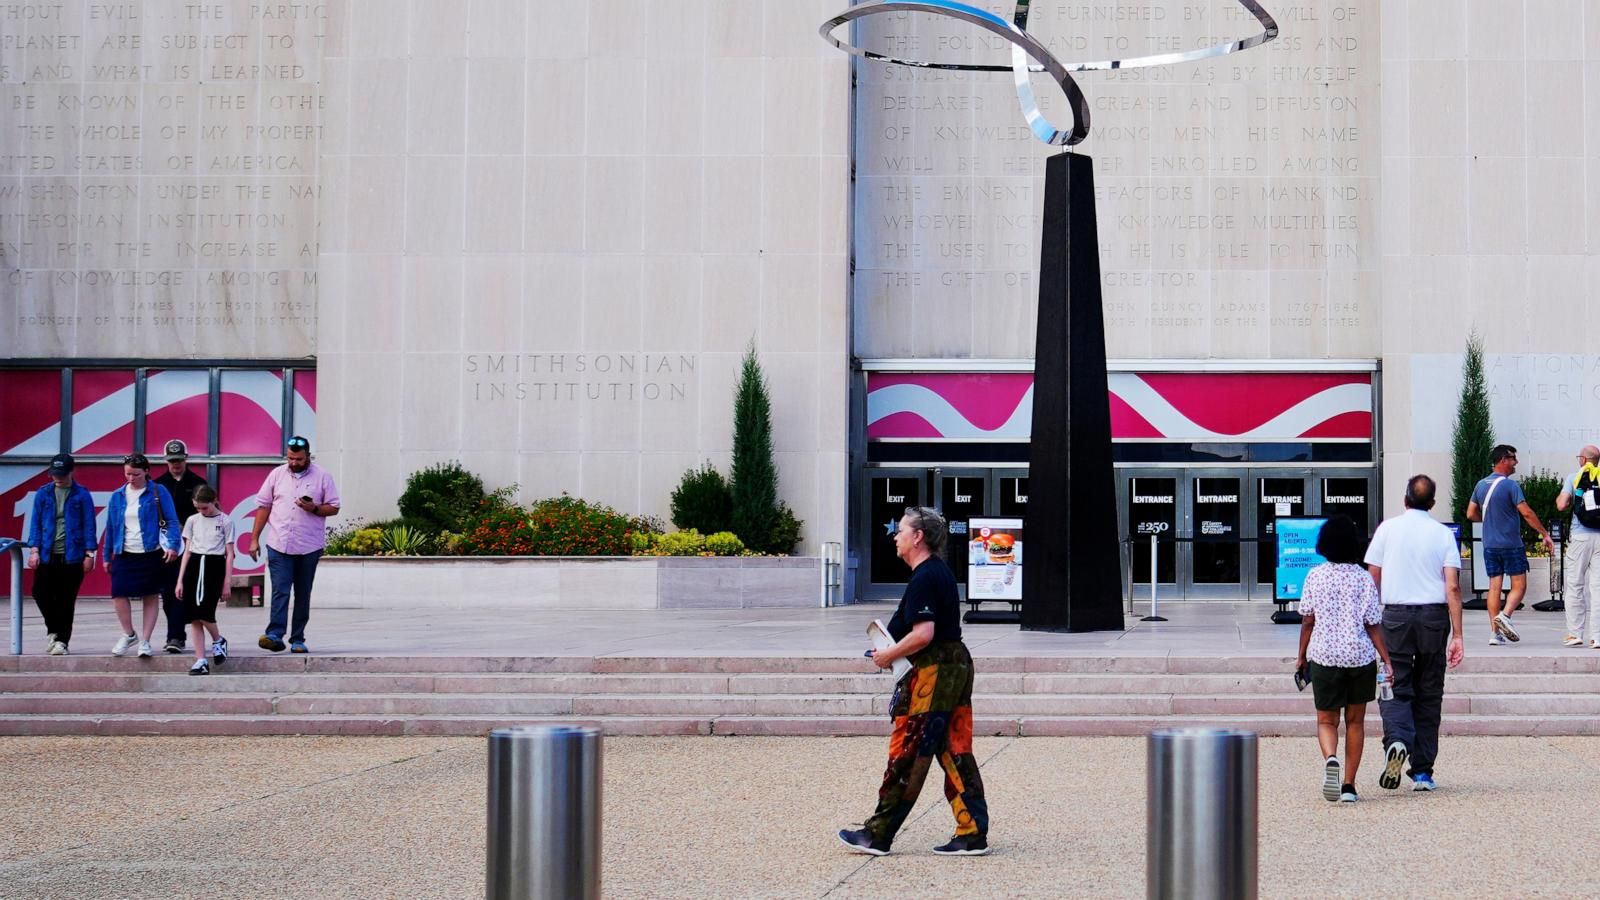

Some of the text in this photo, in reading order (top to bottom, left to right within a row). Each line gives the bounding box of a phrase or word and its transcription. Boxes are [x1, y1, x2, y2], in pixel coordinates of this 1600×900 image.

[0, 5, 64, 19] HOUT
[90, 5, 137, 19] EVIL
[185, 5, 224, 19] THE
[1057, 6, 1166, 21] FURNISHED
[1183, 6, 1207, 21] BY
[1333, 7, 1357, 21] OF
[101, 35, 141, 49] ARE
[160, 35, 248, 49] SUBJECT
[265, 35, 294, 49] TO
[883, 36, 920, 50] THE
[1047, 36, 1088, 50] AND
[1103, 36, 1129, 50] TO
[1145, 36, 1182, 50] THE
[1315, 36, 1358, 50] AND
[32, 65, 73, 80] AND
[91, 65, 152, 80] WHAT
[174, 65, 190, 80] IS
[211, 65, 305, 80] LEARNED
[1192, 66, 1215, 81] AS
[1232, 66, 1257, 81] BY
[1273, 67, 1357, 81] HIMSELF
[12, 95, 36, 110] BE
[57, 95, 137, 110] KNOWN
[159, 95, 184, 110] OF
[207, 95, 245, 110] THE
[884, 96, 984, 111] DECLARED
[1190, 96, 1232, 111] AND
[17, 125, 54, 140] THE
[71, 125, 141, 140] WHOLE
[160, 125, 186, 140] OF
[201, 125, 228, 140] MY
[885, 126, 911, 141] OF
[1093, 126, 1150, 141] MONG
[1174, 126, 1216, 141] MEN
[1248, 126, 1281, 141] HIS
[1302, 126, 1358, 141] NAME
[73, 155, 144, 170] STATES
[167, 155, 193, 170] OF
[958, 156, 981, 171] BE
[1151, 156, 1257, 171] ENROLLED
[1282, 156, 1359, 171] AMONG
[157, 185, 220, 200] UNDER
[235, 185, 271, 200] THE
[882, 186, 920, 200] THE
[1214, 186, 1241, 200] OF
[0, 214, 123, 228] ITHSONIAN
[1252, 215, 1359, 229] MULTIPLIES
[58, 242, 97, 257] FOR
[114, 242, 152, 257] THE
[176, 242, 277, 257] INCREASE
[883, 243, 920, 258] THE
[940, 243, 985, 258] USES
[1004, 243, 1028, 258] TO
[1130, 243, 1150, 258] HE
[1171, 243, 1186, 258] IS
[1269, 243, 1290, 258] TO
[1309, 243, 1359, 258] TURN
[8, 271, 33, 286] OF
[56, 271, 184, 286] KNOWLEDGE
[206, 271, 280, 286] AMONG
[882, 272, 920, 287] THE
[1005, 272, 1028, 287] OF
[466, 355, 696, 373] SMITHSONIAN
[1491, 355, 1600, 373] ATIONA
[475, 383, 686, 400] INSTITUTION
[888, 495, 905, 503] EXIT
[957, 495, 972, 503] EXIT
[1135, 495, 1173, 503] ENTRANCE
[1199, 495, 1238, 503] ENTRANCE
[1263, 495, 1302, 503] ENTRANCE
[1327, 495, 1364, 503] ENTRANCE
[1146, 521, 1169, 534] 250
